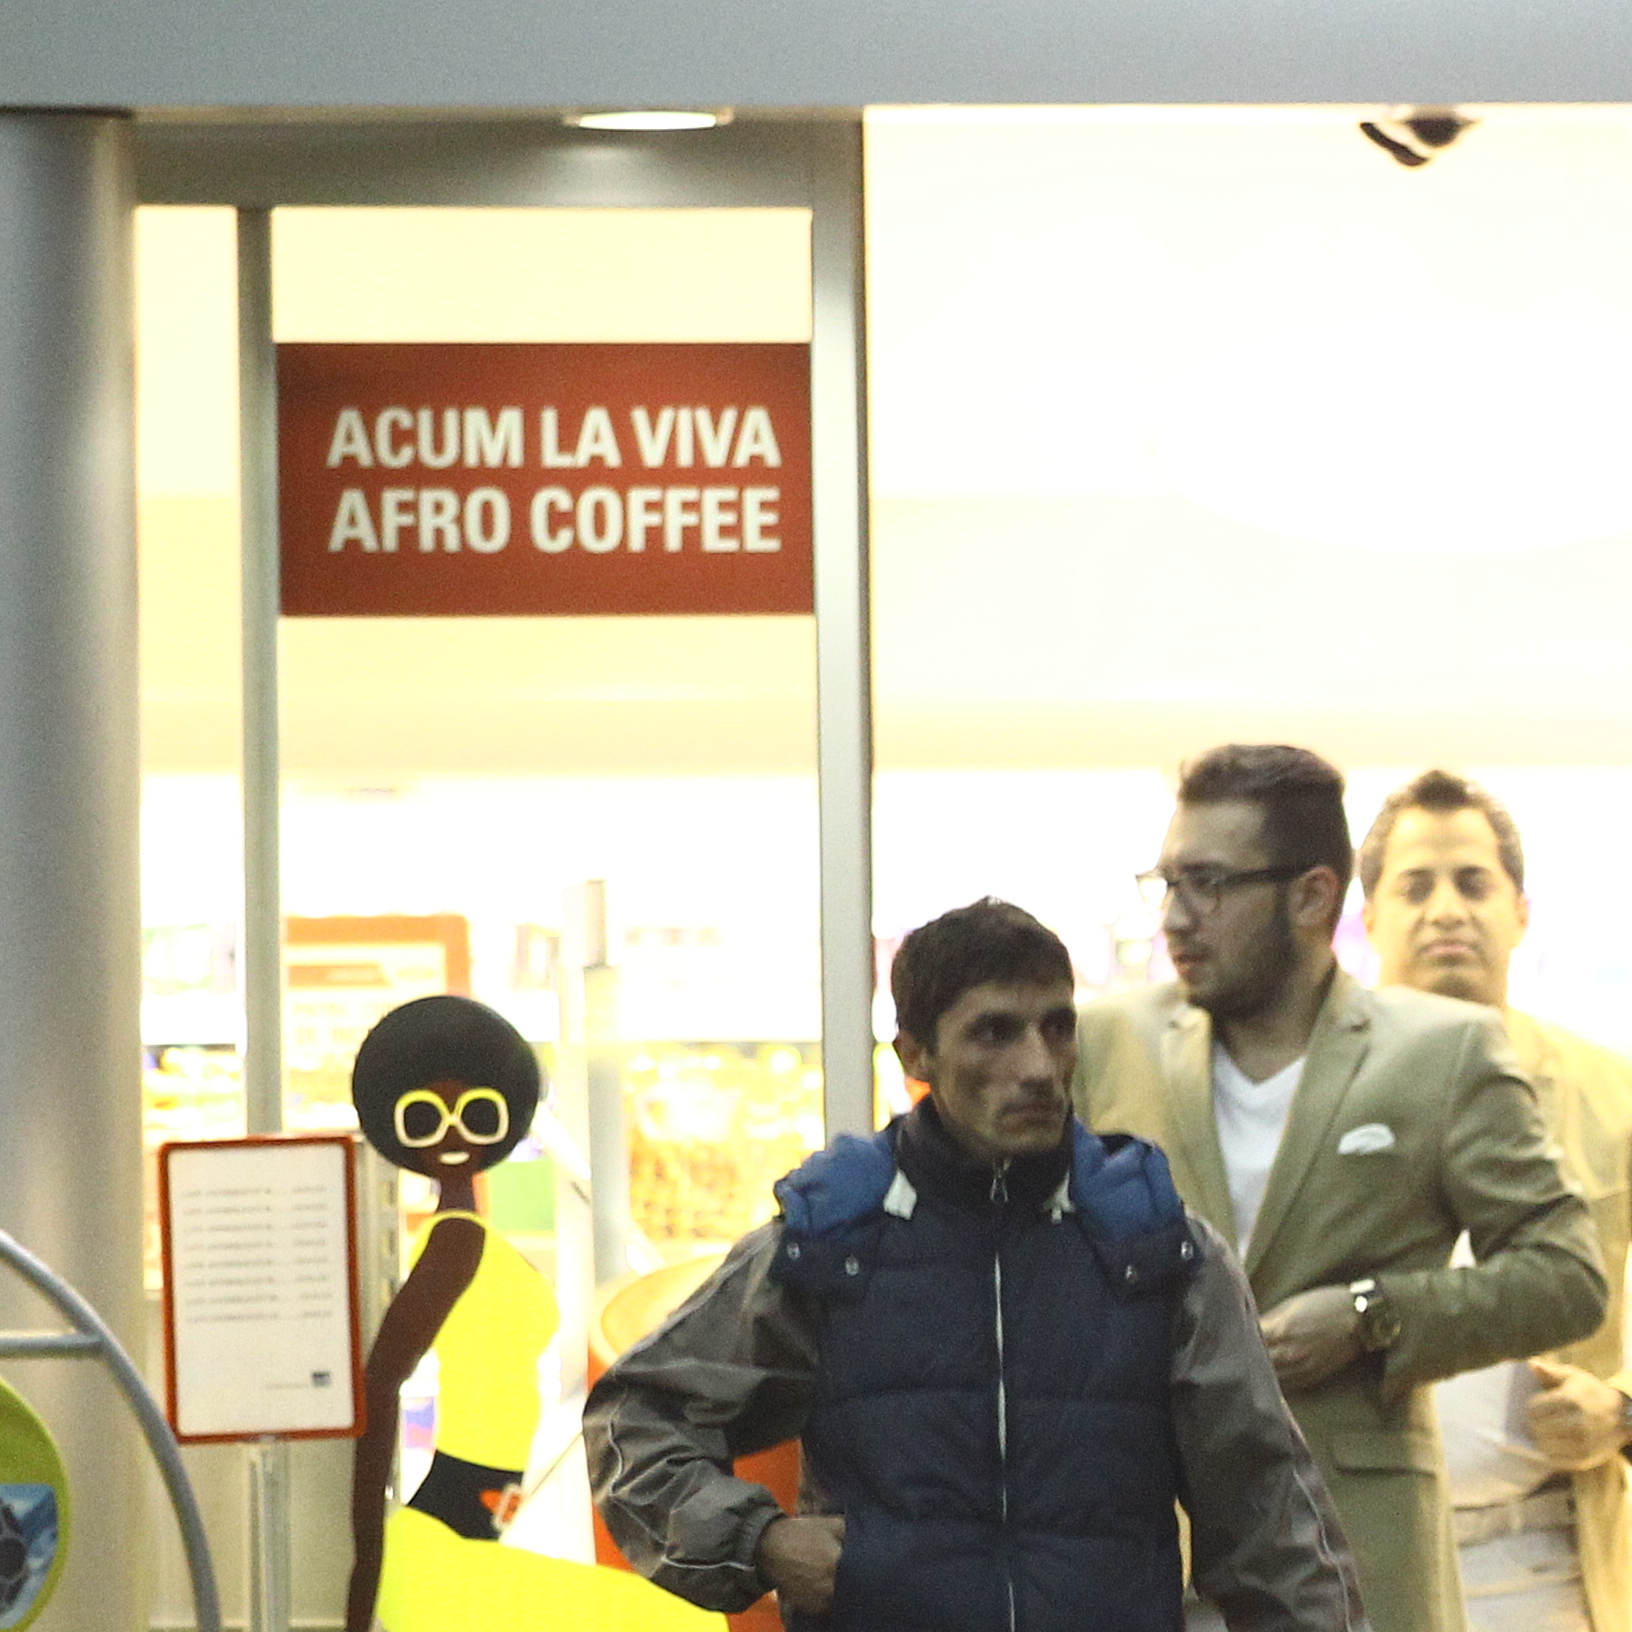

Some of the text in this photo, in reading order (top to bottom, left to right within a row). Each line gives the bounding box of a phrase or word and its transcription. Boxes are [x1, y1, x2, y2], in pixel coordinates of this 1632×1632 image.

[326, 405, 781, 468] ACUM LA VIVA
[327, 485, 781, 554] AFRO COFFEE
